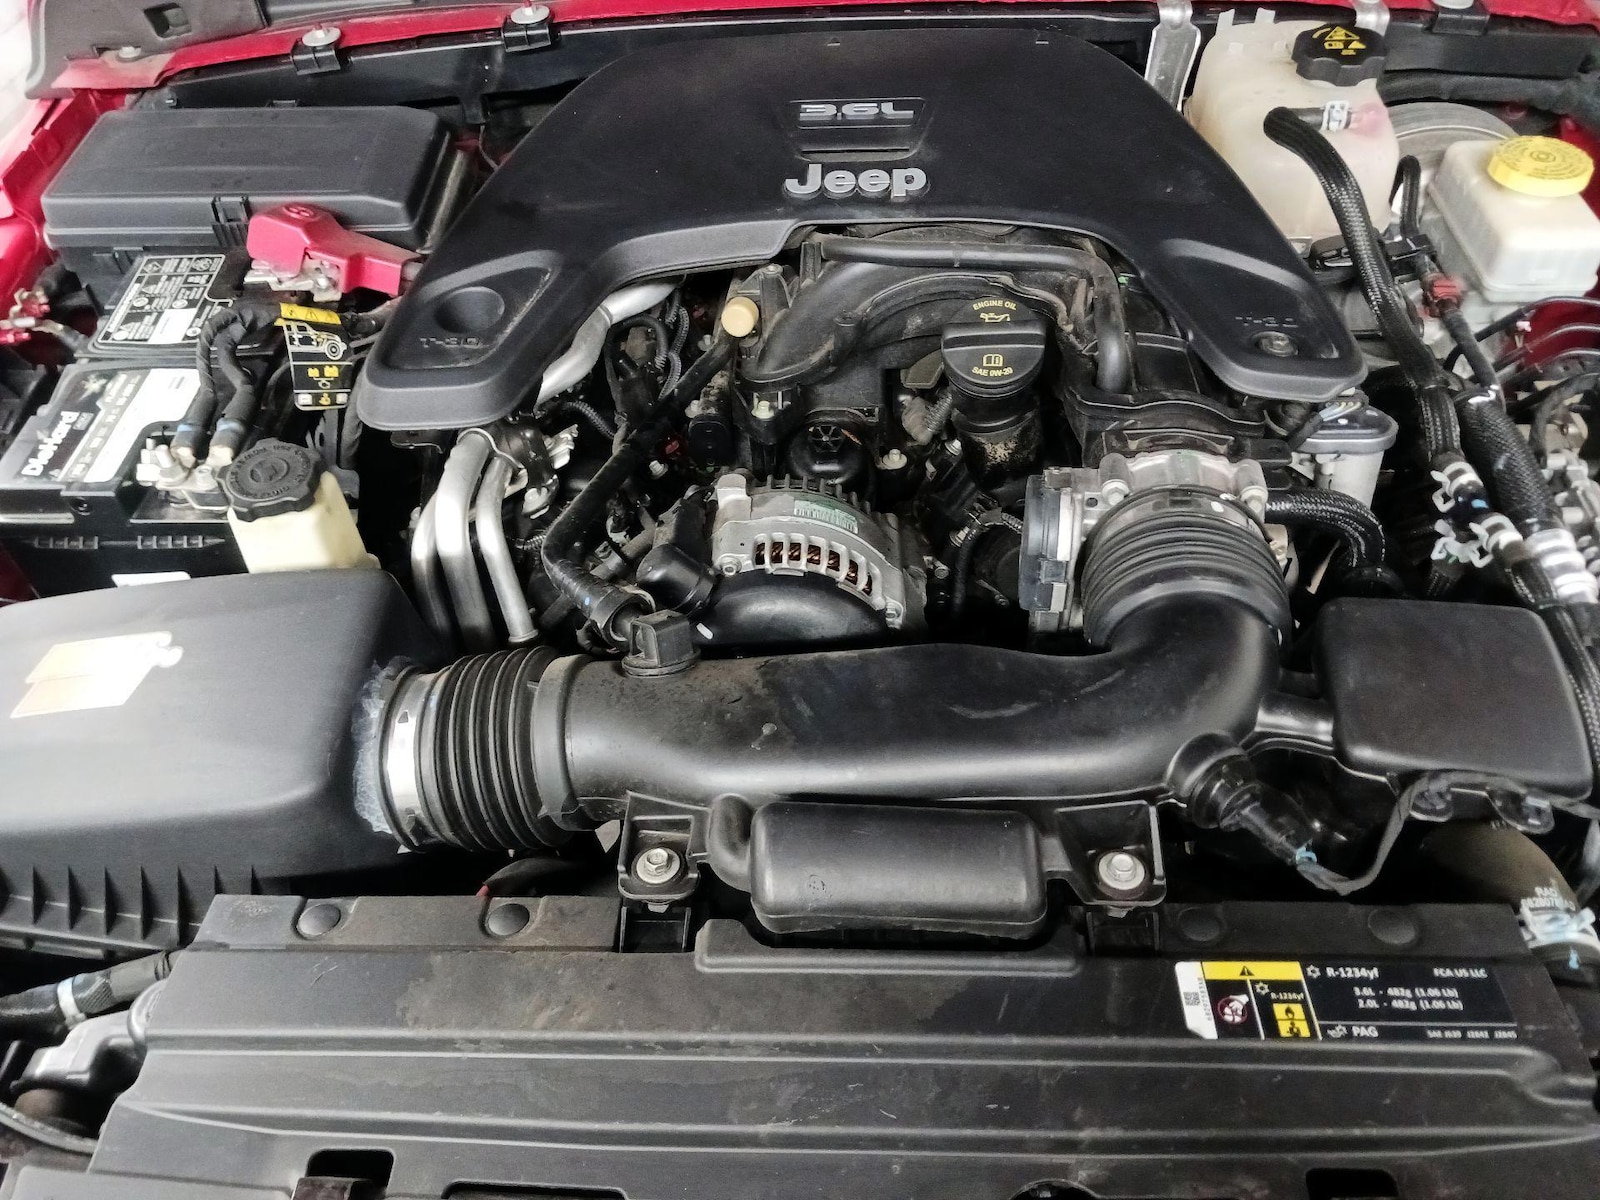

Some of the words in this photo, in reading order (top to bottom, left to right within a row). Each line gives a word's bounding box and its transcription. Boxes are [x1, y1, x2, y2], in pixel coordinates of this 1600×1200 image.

[799, 102, 914, 121] 3.6L
[784, 163, 929, 202] Jeep
[972, 300, 1003, 311] ENGINE
[1004, 301, 1017, 311] OIL
[972, 366, 988, 376] SAE
[989, 366, 1013, 377] 0W-20
[20, 411, 80, 477] DieHard
[1326, 967, 1379, 981] R-1234yf
[1433, 967, 1452, 978] FCA
[1453, 968, 1469, 978] US
[1470, 968, 1488, 979] LLC
[1352, 1025, 1379, 1038] PAG
